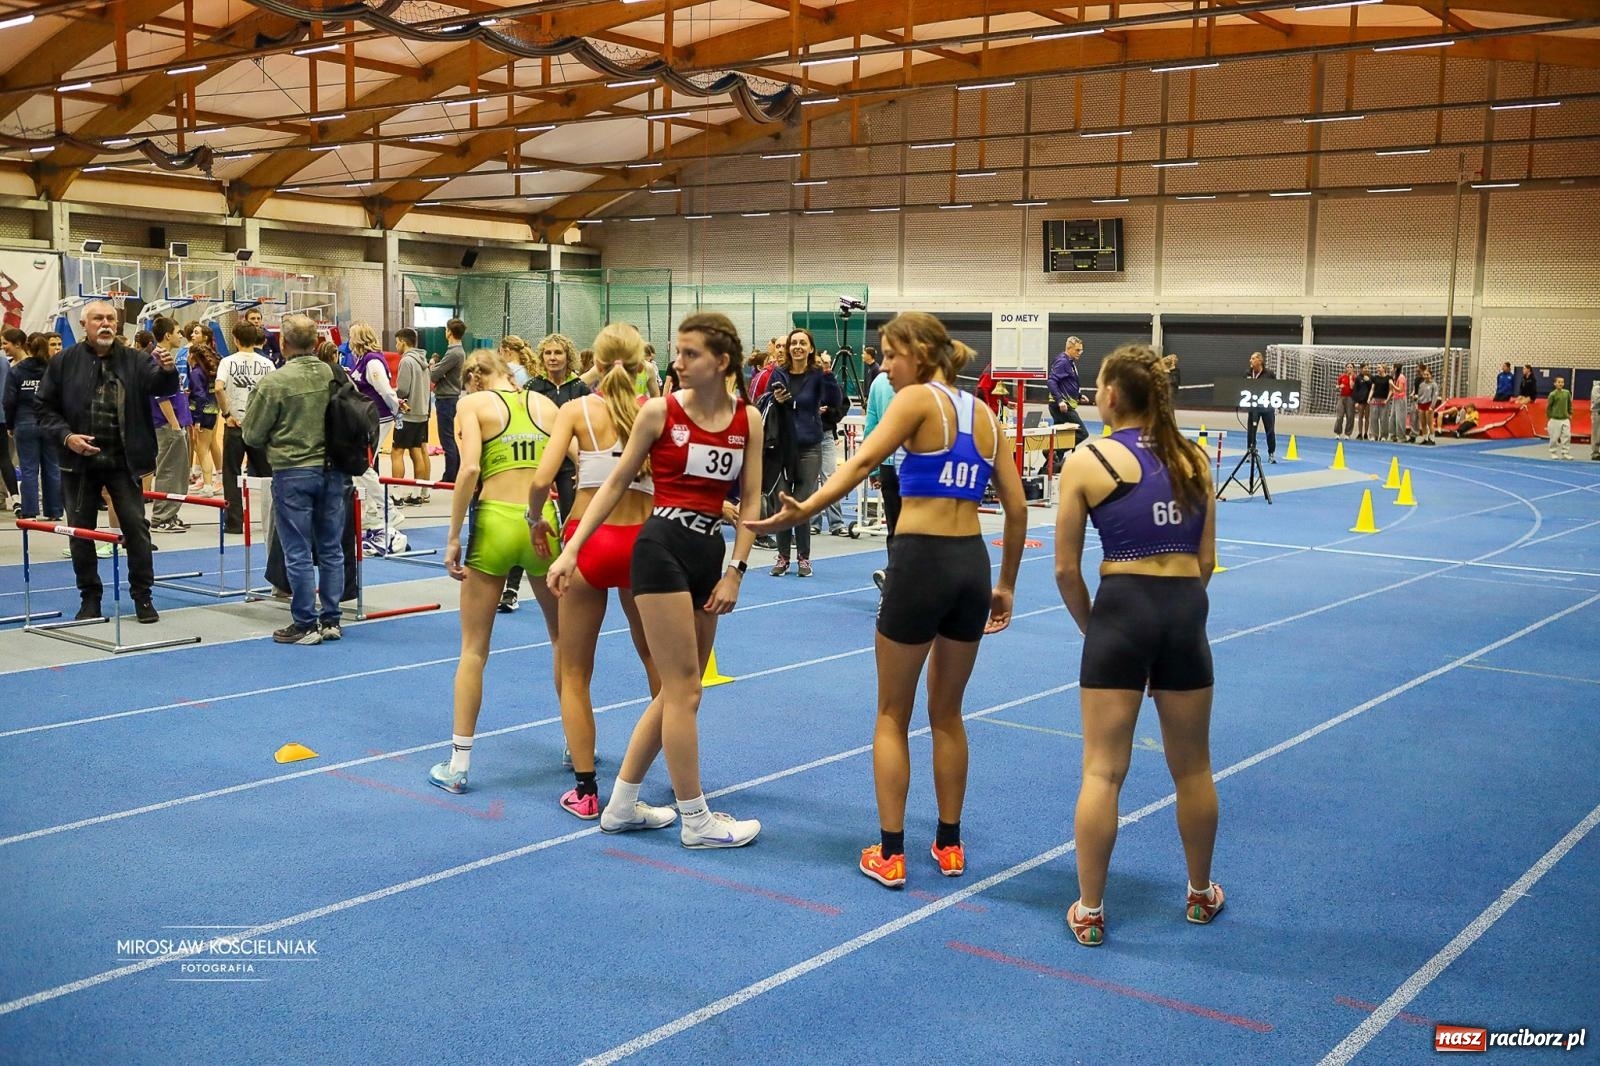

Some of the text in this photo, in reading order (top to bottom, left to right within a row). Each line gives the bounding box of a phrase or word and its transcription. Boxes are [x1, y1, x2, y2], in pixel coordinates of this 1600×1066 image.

[1001, 314, 1039, 322] DO METY
[1239, 390, 1300, 409] 2:46.5
[511, 441, 535, 461] 111
[705, 450, 733, 475] 39
[938, 461, 979, 489] 401
[1152, 501, 1182, 526] 66
